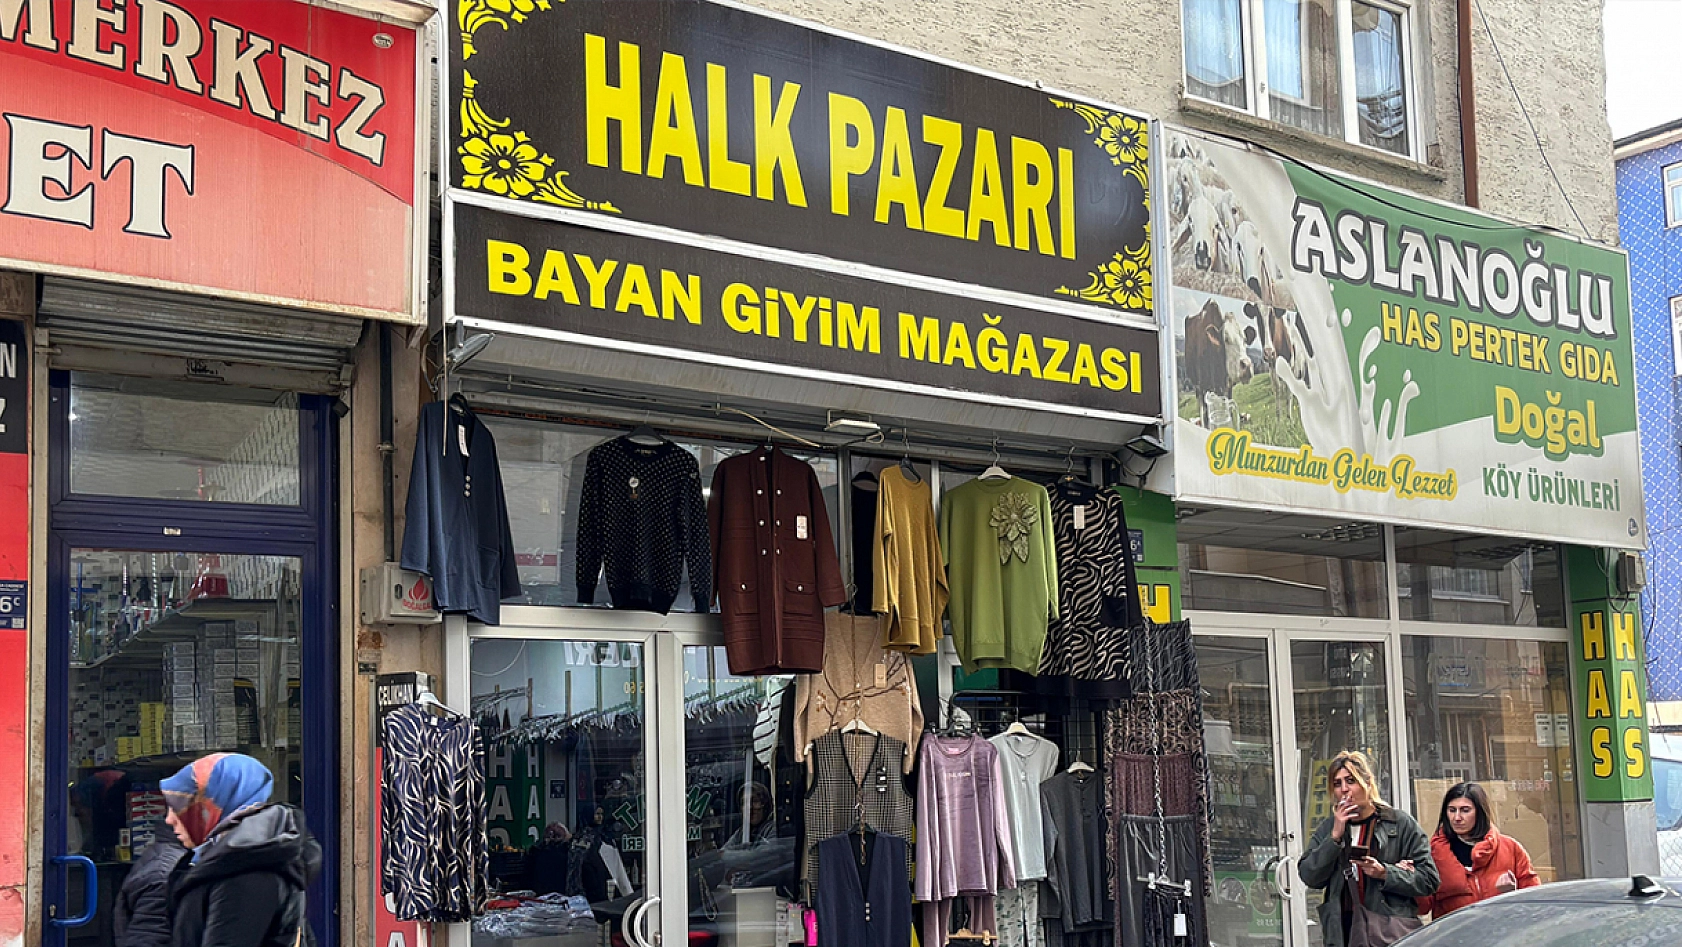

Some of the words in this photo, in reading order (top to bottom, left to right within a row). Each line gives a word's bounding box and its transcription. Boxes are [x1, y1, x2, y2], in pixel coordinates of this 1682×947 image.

[584, 33, 806, 208] HALK
[828, 91, 1076, 260] PAZARI
[487, 239, 701, 325] BAYAN
[898, 313, 1142, 393] MAĞAZASI
[1295, 201, 1613, 337] ASLANOĞLU
[1381, 303, 1441, 351] HAS
[1451, 316, 1551, 374] PERTEK
[1560, 340, 1620, 386] GIDA
[1210, 432, 1328, 481] Munzurdan
[1333, 459, 1387, 489] Gelen
[1392, 460, 1455, 496] Lezzet
[1495, 385, 1600, 453] Doğal
[1482, 466, 1522, 498] KÖY
[1527, 470, 1621, 512] ÜRÜNLERİ
[1581, 611, 1613, 778] HAS
[1612, 612, 1644, 778] HAS
